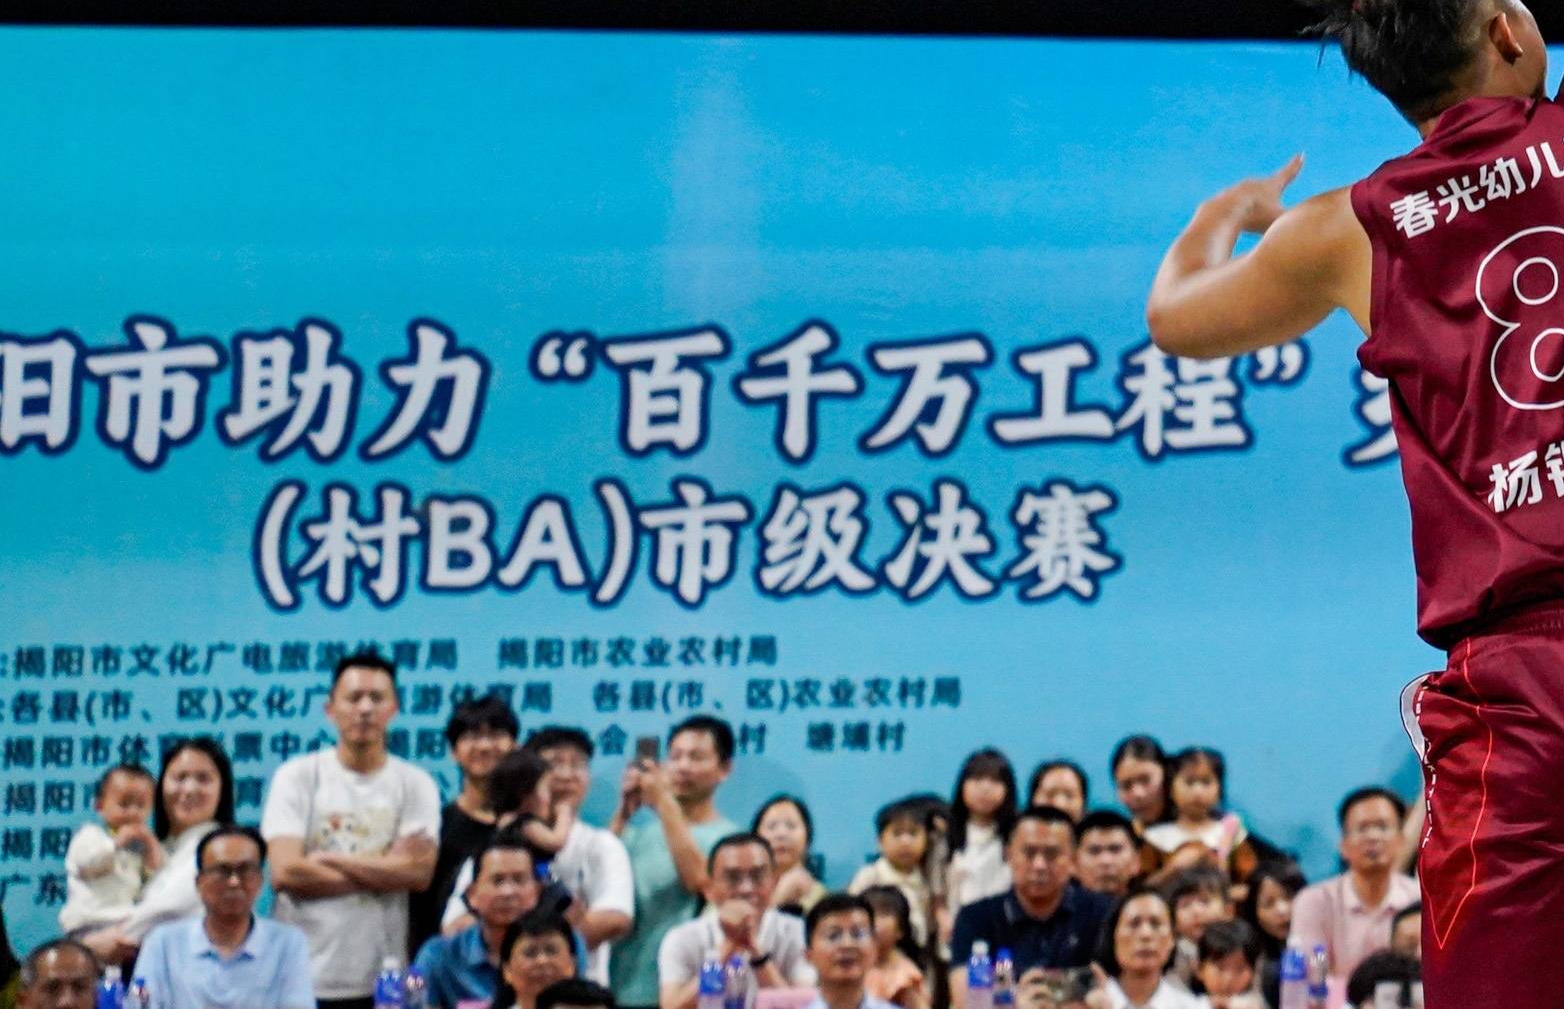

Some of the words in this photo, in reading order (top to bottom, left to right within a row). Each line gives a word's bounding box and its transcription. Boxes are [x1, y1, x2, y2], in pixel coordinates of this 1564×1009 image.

[251, 475, 1123, 613] (村BA)市级决赛
[497, 634, 779, 669] 揭阳市农业农村局
